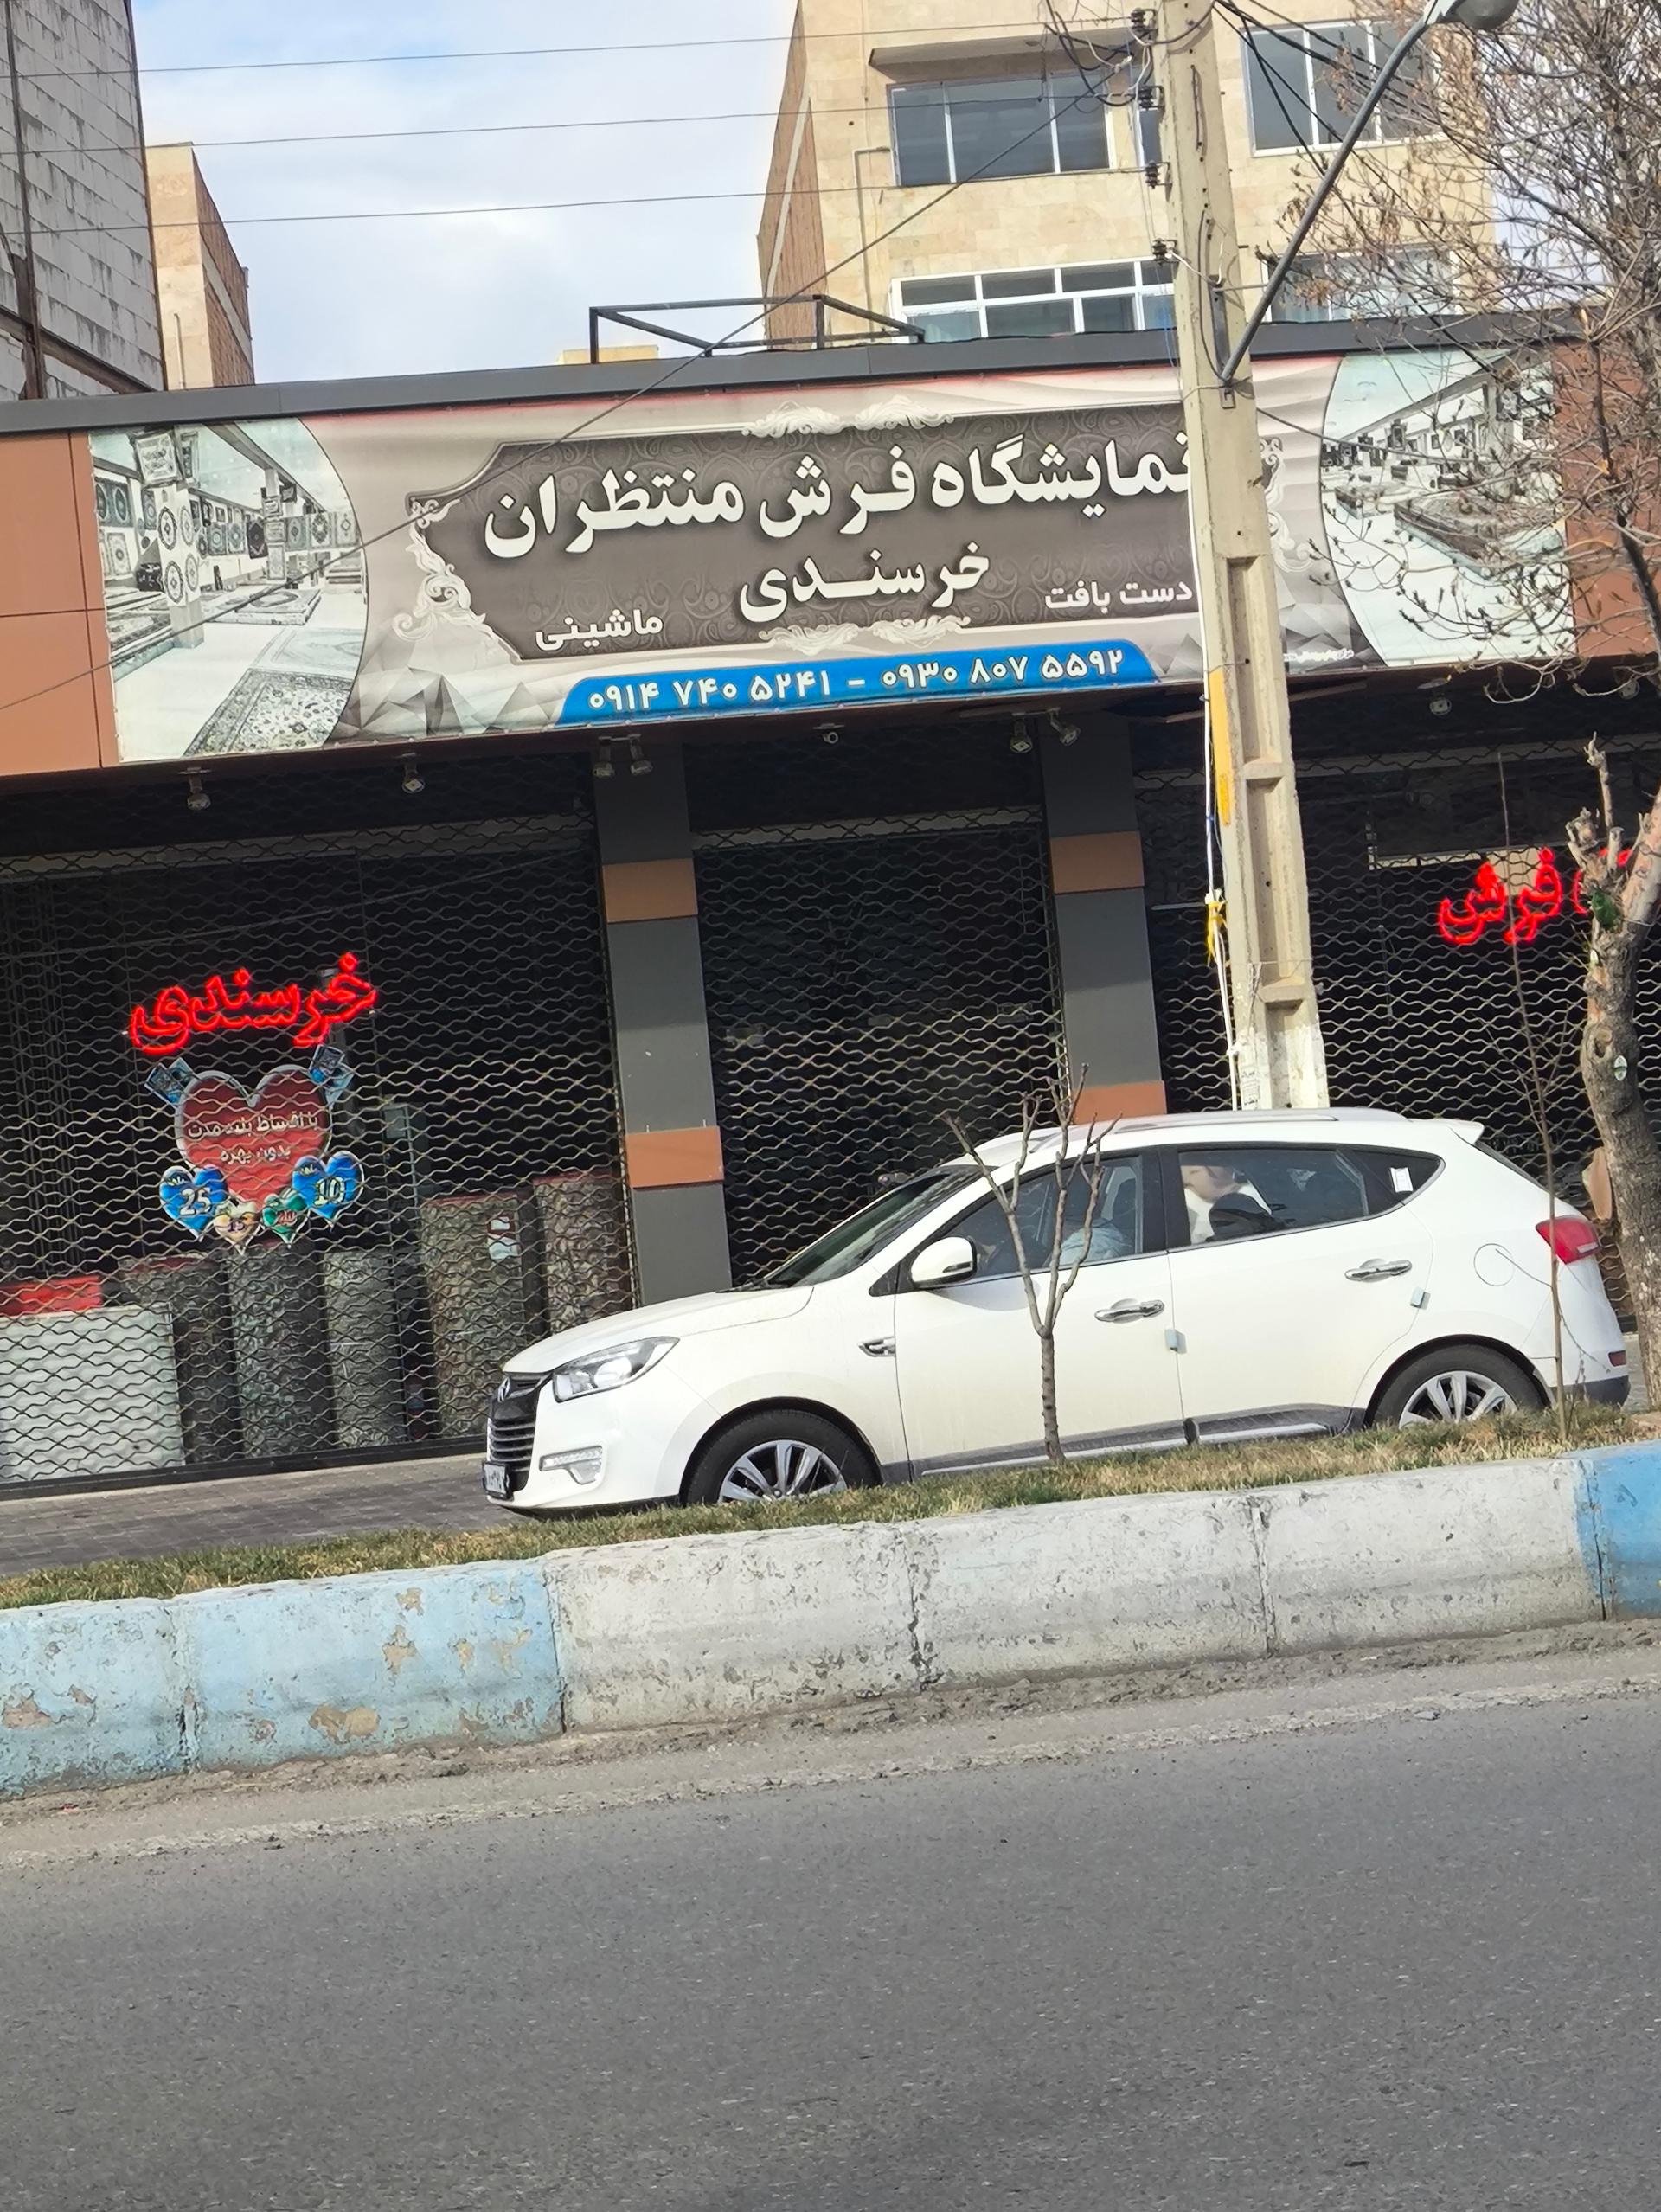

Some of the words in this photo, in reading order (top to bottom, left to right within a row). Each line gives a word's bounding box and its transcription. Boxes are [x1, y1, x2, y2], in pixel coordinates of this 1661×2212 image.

[759, 445, 917, 538] فرش
[931, 432, 1190, 517] نمایشگاه
[484, 468, 745, 558] منتظران
[740, 542, 990, 622] خرسندی
[1045, 580, 1111, 614] بافت
[1119, 580, 1193, 605] دست
[535, 608, 664, 651] ماشینی
[589, 682, 660, 712] ۰۹۱۴
[672, 677, 738, 706] ۷۴۰
[750, 670, 830, 700] ۵۲۴۱
[882, 661, 958, 689] ۰۹۳۰
[970, 657, 1029, 684] ۸۰۷
[1041, 648, 1124, 679] ۵۵۹۲
[130, 952, 377, 1055] خرسندی
[179, 1187, 212, 1217] 25
[314, 1177, 345, 1205] 10
